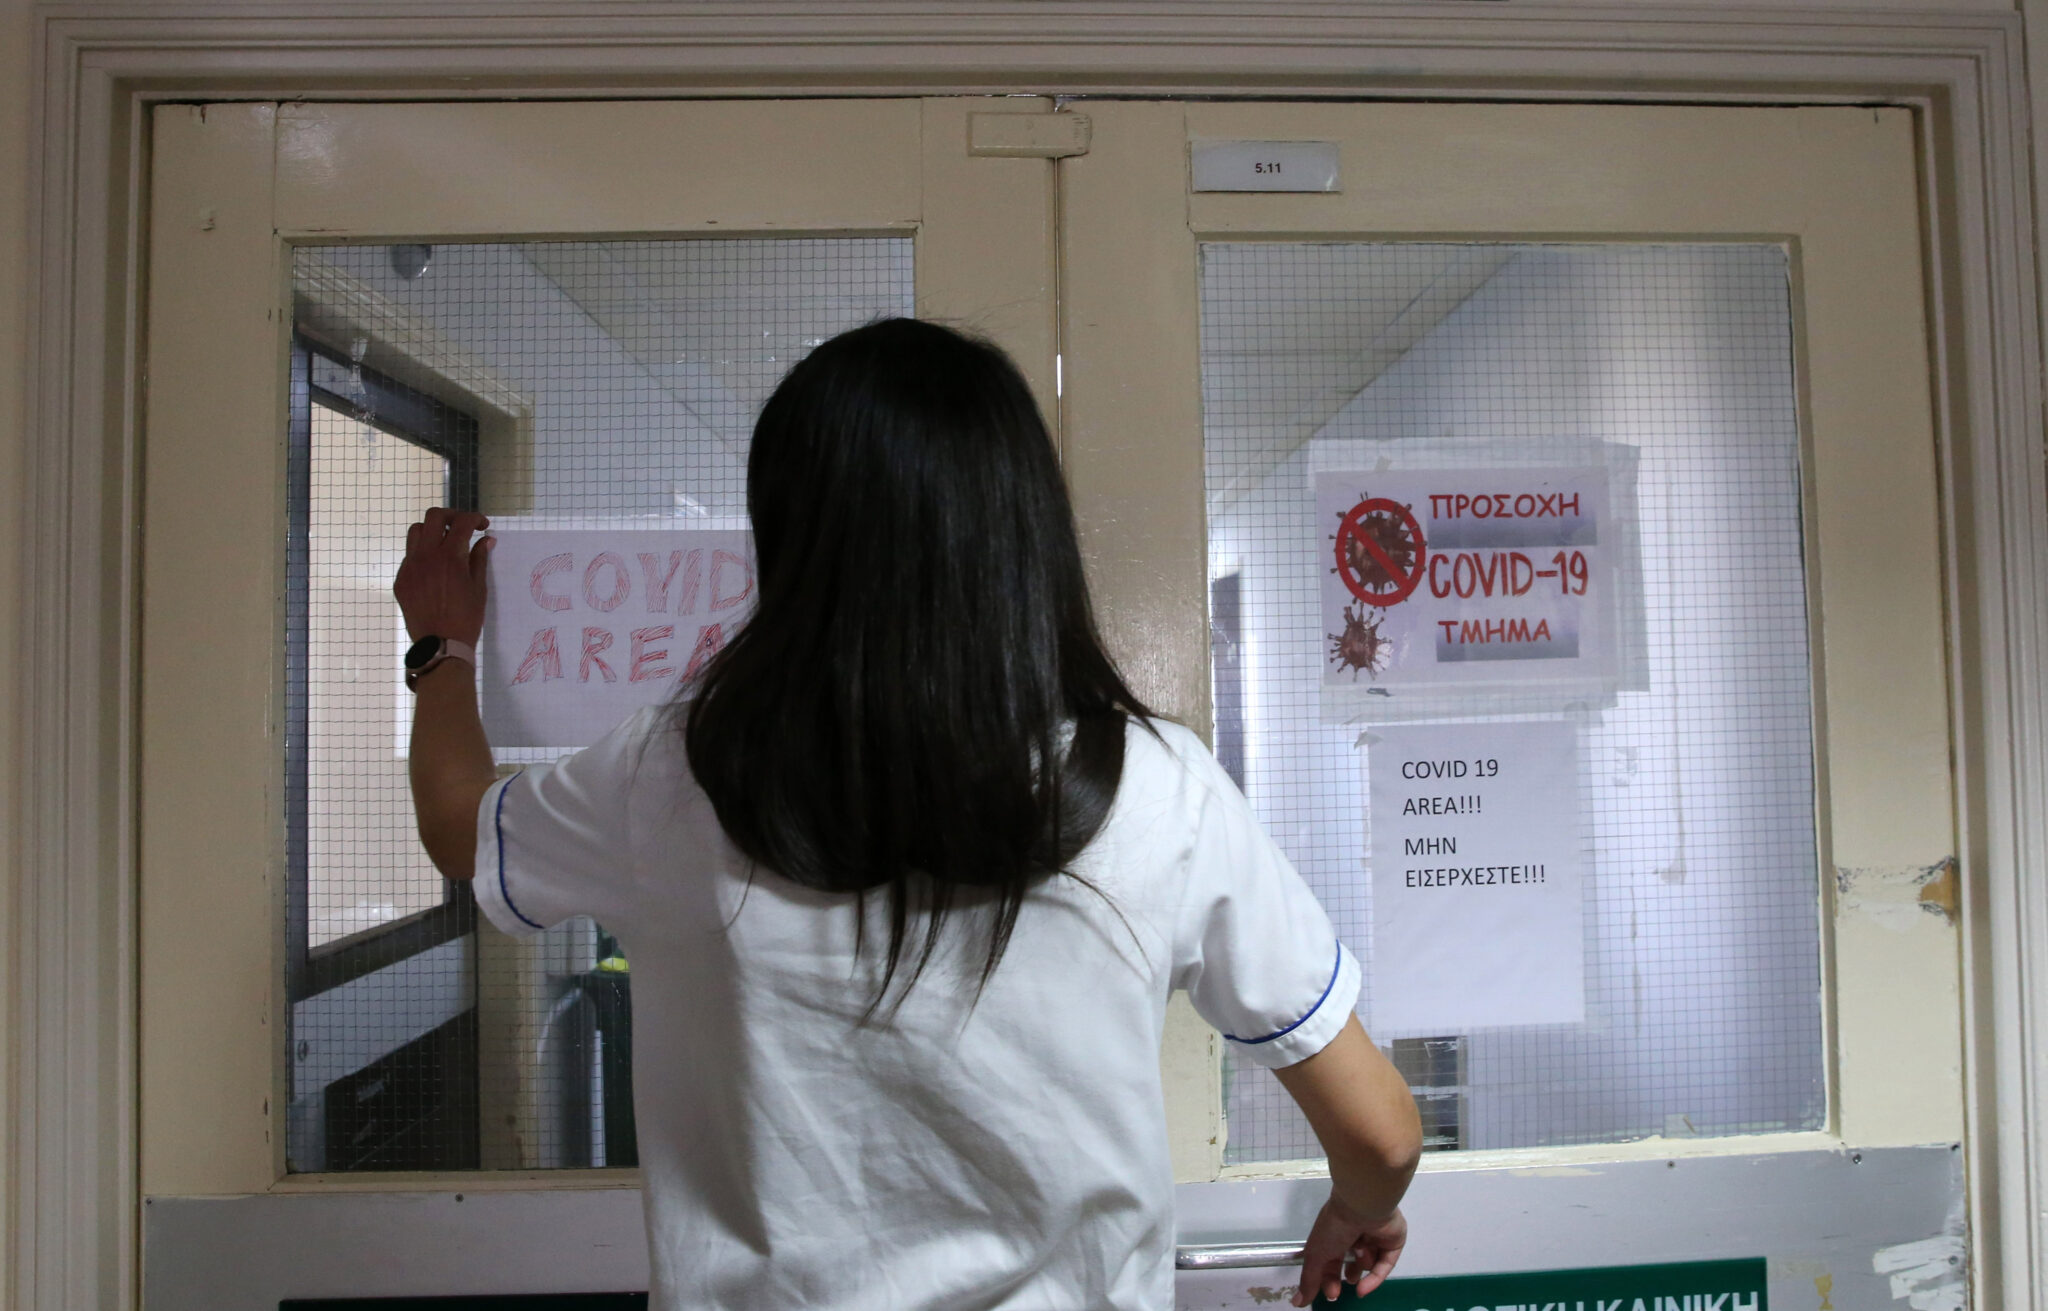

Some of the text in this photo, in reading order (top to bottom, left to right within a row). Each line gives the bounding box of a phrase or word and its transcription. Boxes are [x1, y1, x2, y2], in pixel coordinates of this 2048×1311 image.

[1255, 162, 1281, 174] 5.11
[1428, 492, 1580, 520] ΠΡΟΣΟΧΗ
[530, 549, 755, 616] COVID
[1428, 550, 1589, 599] COVID-19
[1437, 617, 1552, 645] ΤΜΗΜΑ
[1401, 758, 1499, 779] COVID 19
[1402, 795, 1481, 816] AREA!!!
[1404, 837, 1456, 856] ΜΗΝ
[1405, 864, 1545, 888] ΕΙΣΕΡΧΕΣΤΕ!!!
